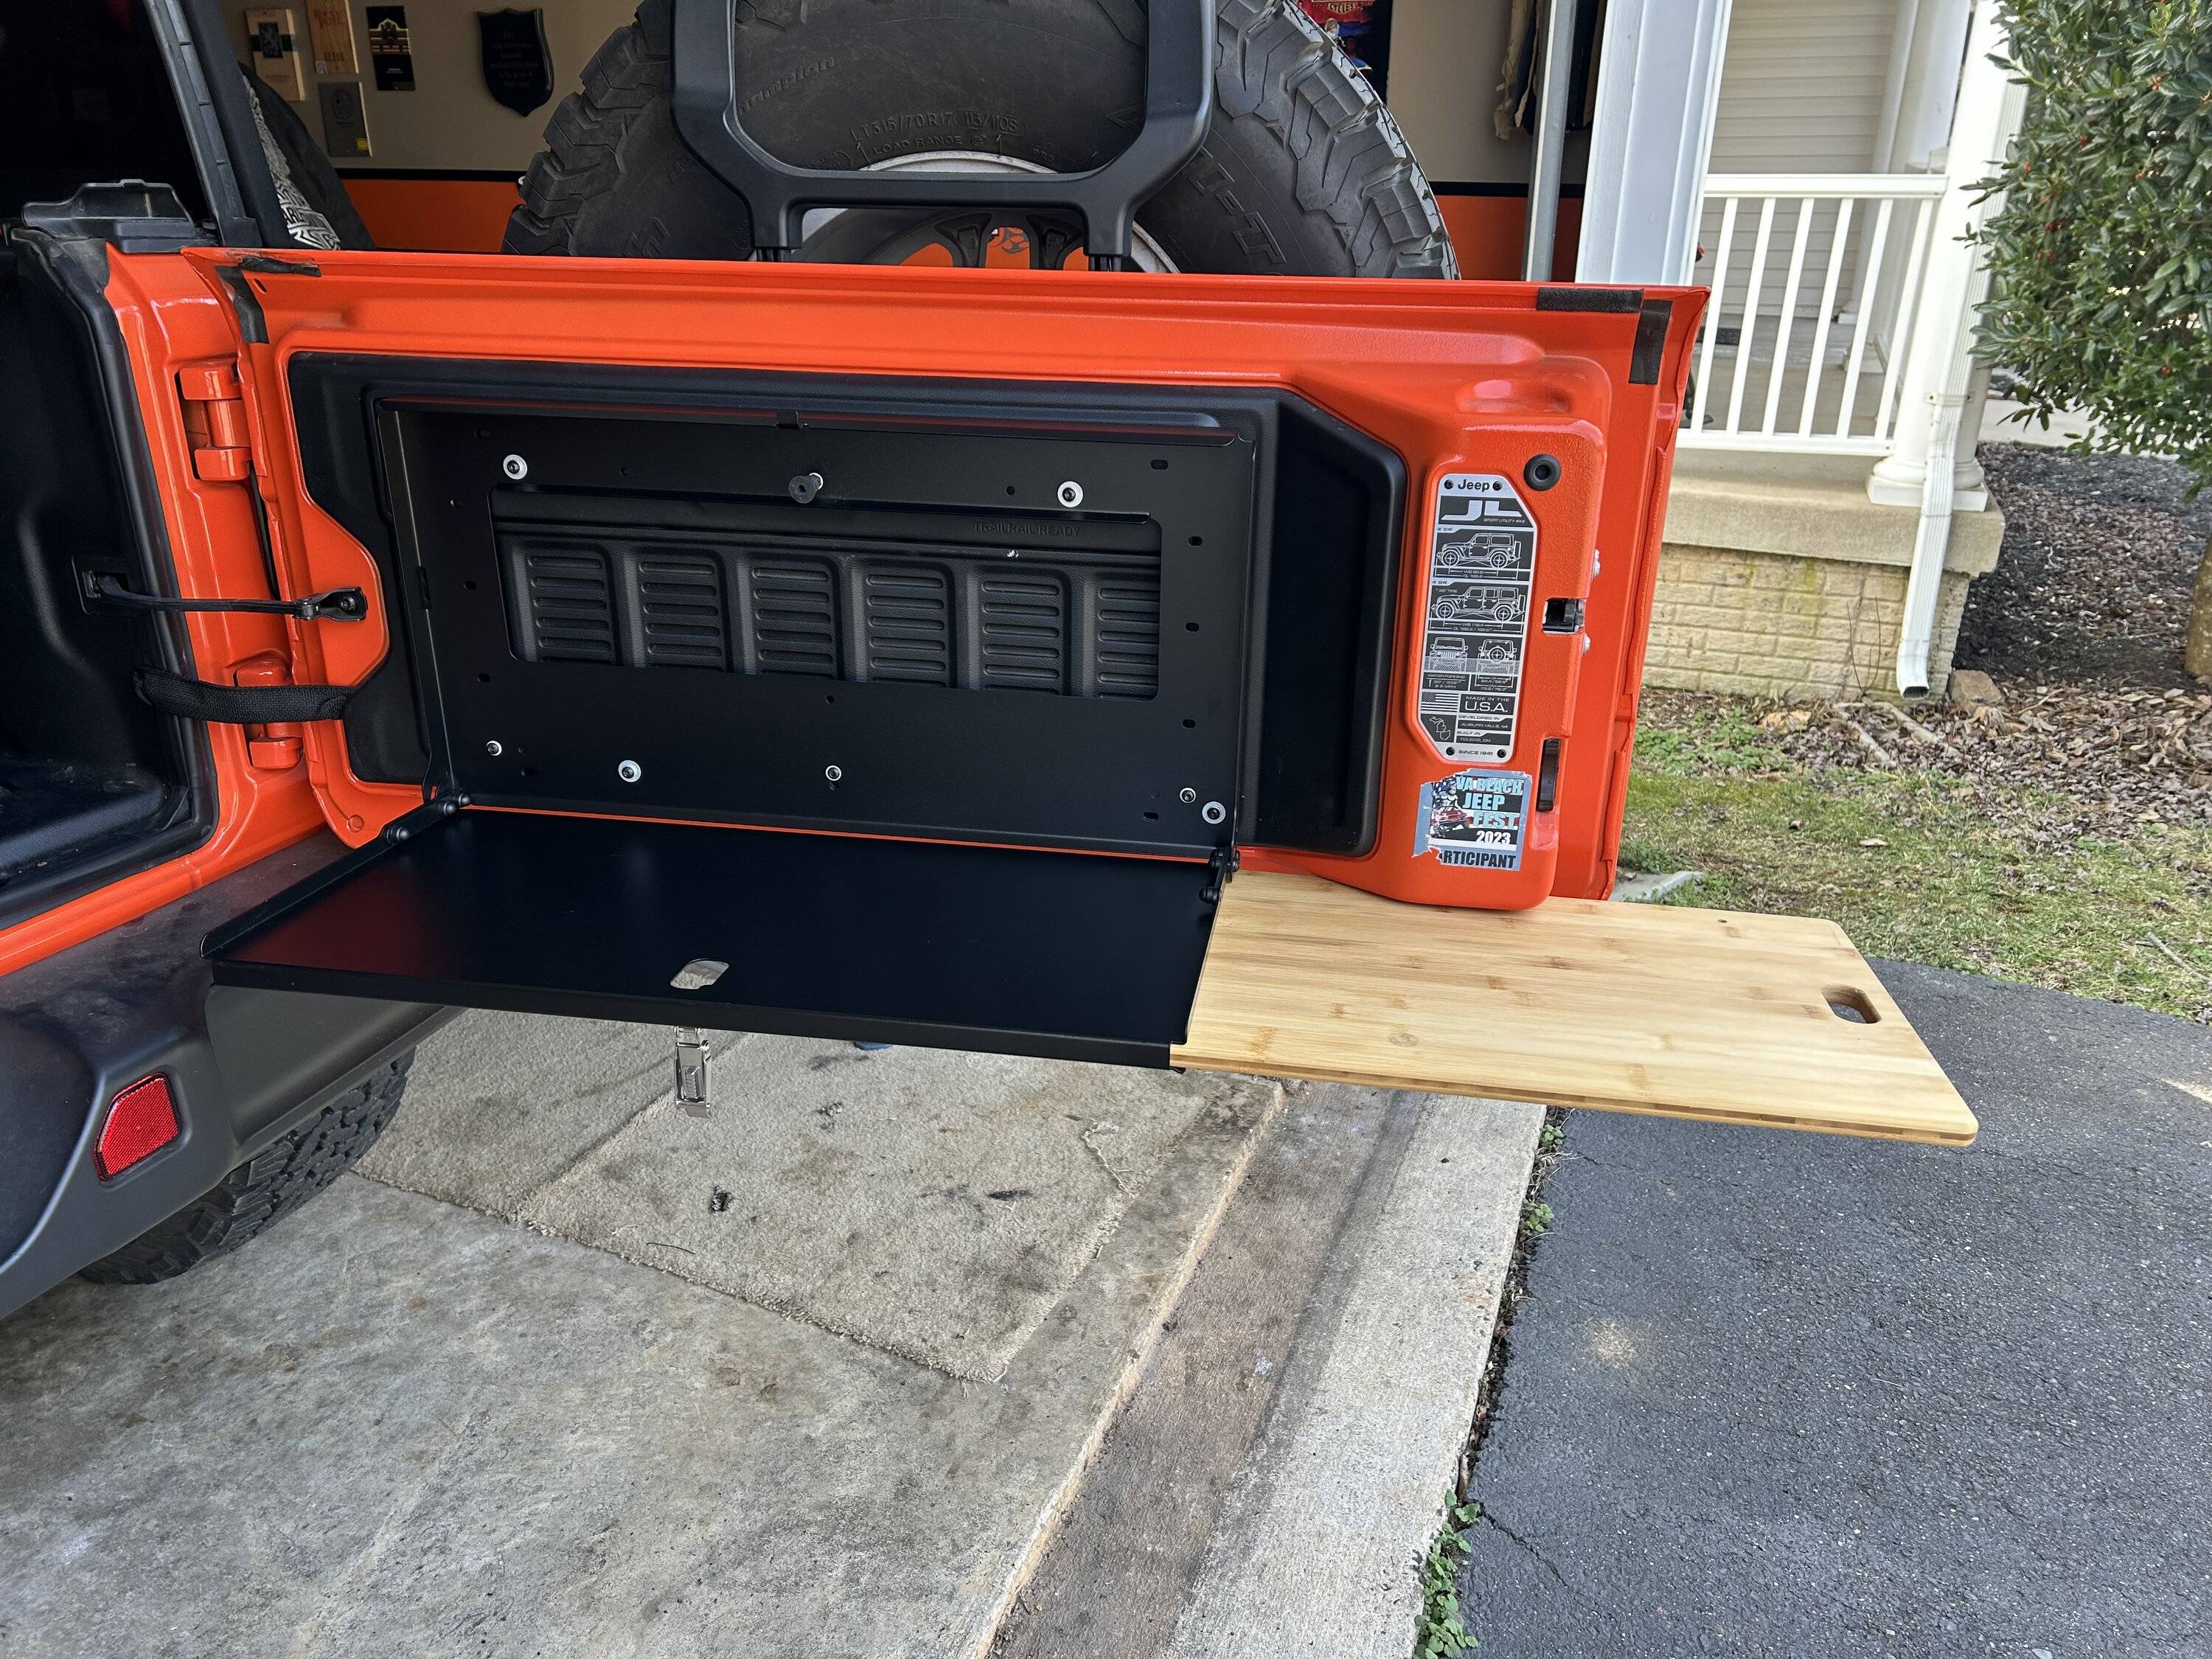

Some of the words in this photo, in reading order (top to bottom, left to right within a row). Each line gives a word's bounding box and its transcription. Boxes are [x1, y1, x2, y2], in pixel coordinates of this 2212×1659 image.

[1329, 2, 1356, 13] CYCLES
[872, 139, 911, 156] LOAD
[914, 135, 964, 148] RANGE
[1458, 479, 1490, 492] Jeep
[1441, 499, 1523, 521] JL
[1038, 525, 1081, 538] READY
[1464, 701, 1509, 713] U.S.A.
[1455, 776, 1473, 790] VA
[1476, 778, 1523, 795] BEACH
[1463, 793, 1506, 810] JEEP
[1472, 811, 1519, 830] FEST
[1476, 830, 1511, 844] 2023
[1439, 849, 1517, 869] RTICIPANT
